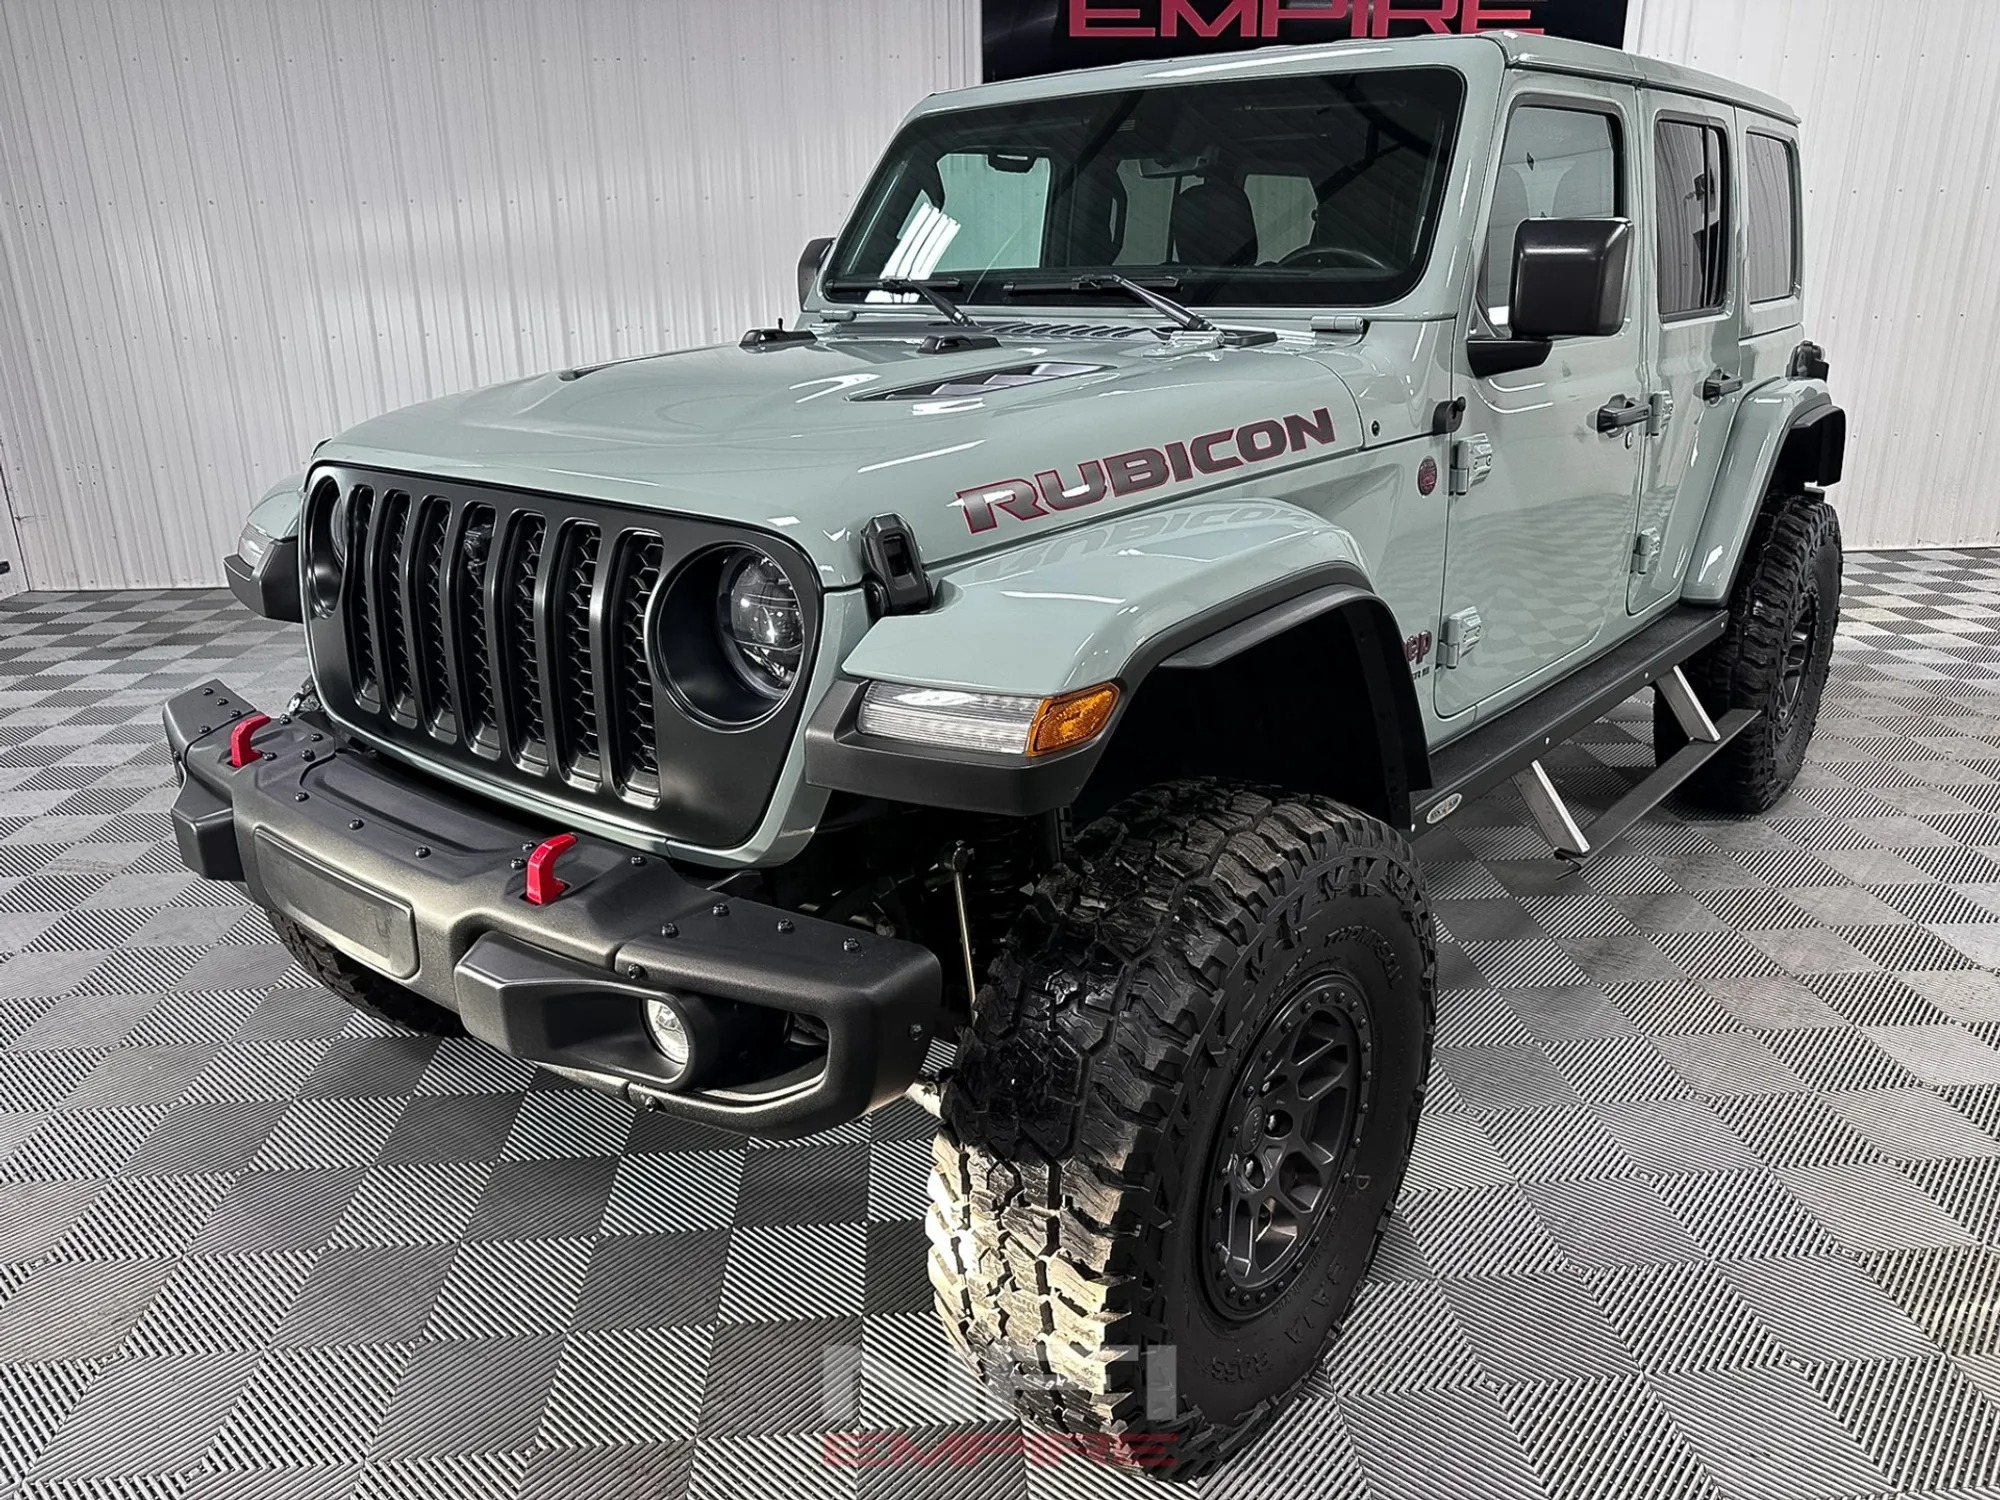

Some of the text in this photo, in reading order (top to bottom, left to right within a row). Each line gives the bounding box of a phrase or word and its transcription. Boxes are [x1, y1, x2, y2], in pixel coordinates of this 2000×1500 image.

[1068, 0, 1546, 38] EMPIRE
[957, 407, 1336, 534] RUBICON
[1404, 630, 1432, 665] ep
